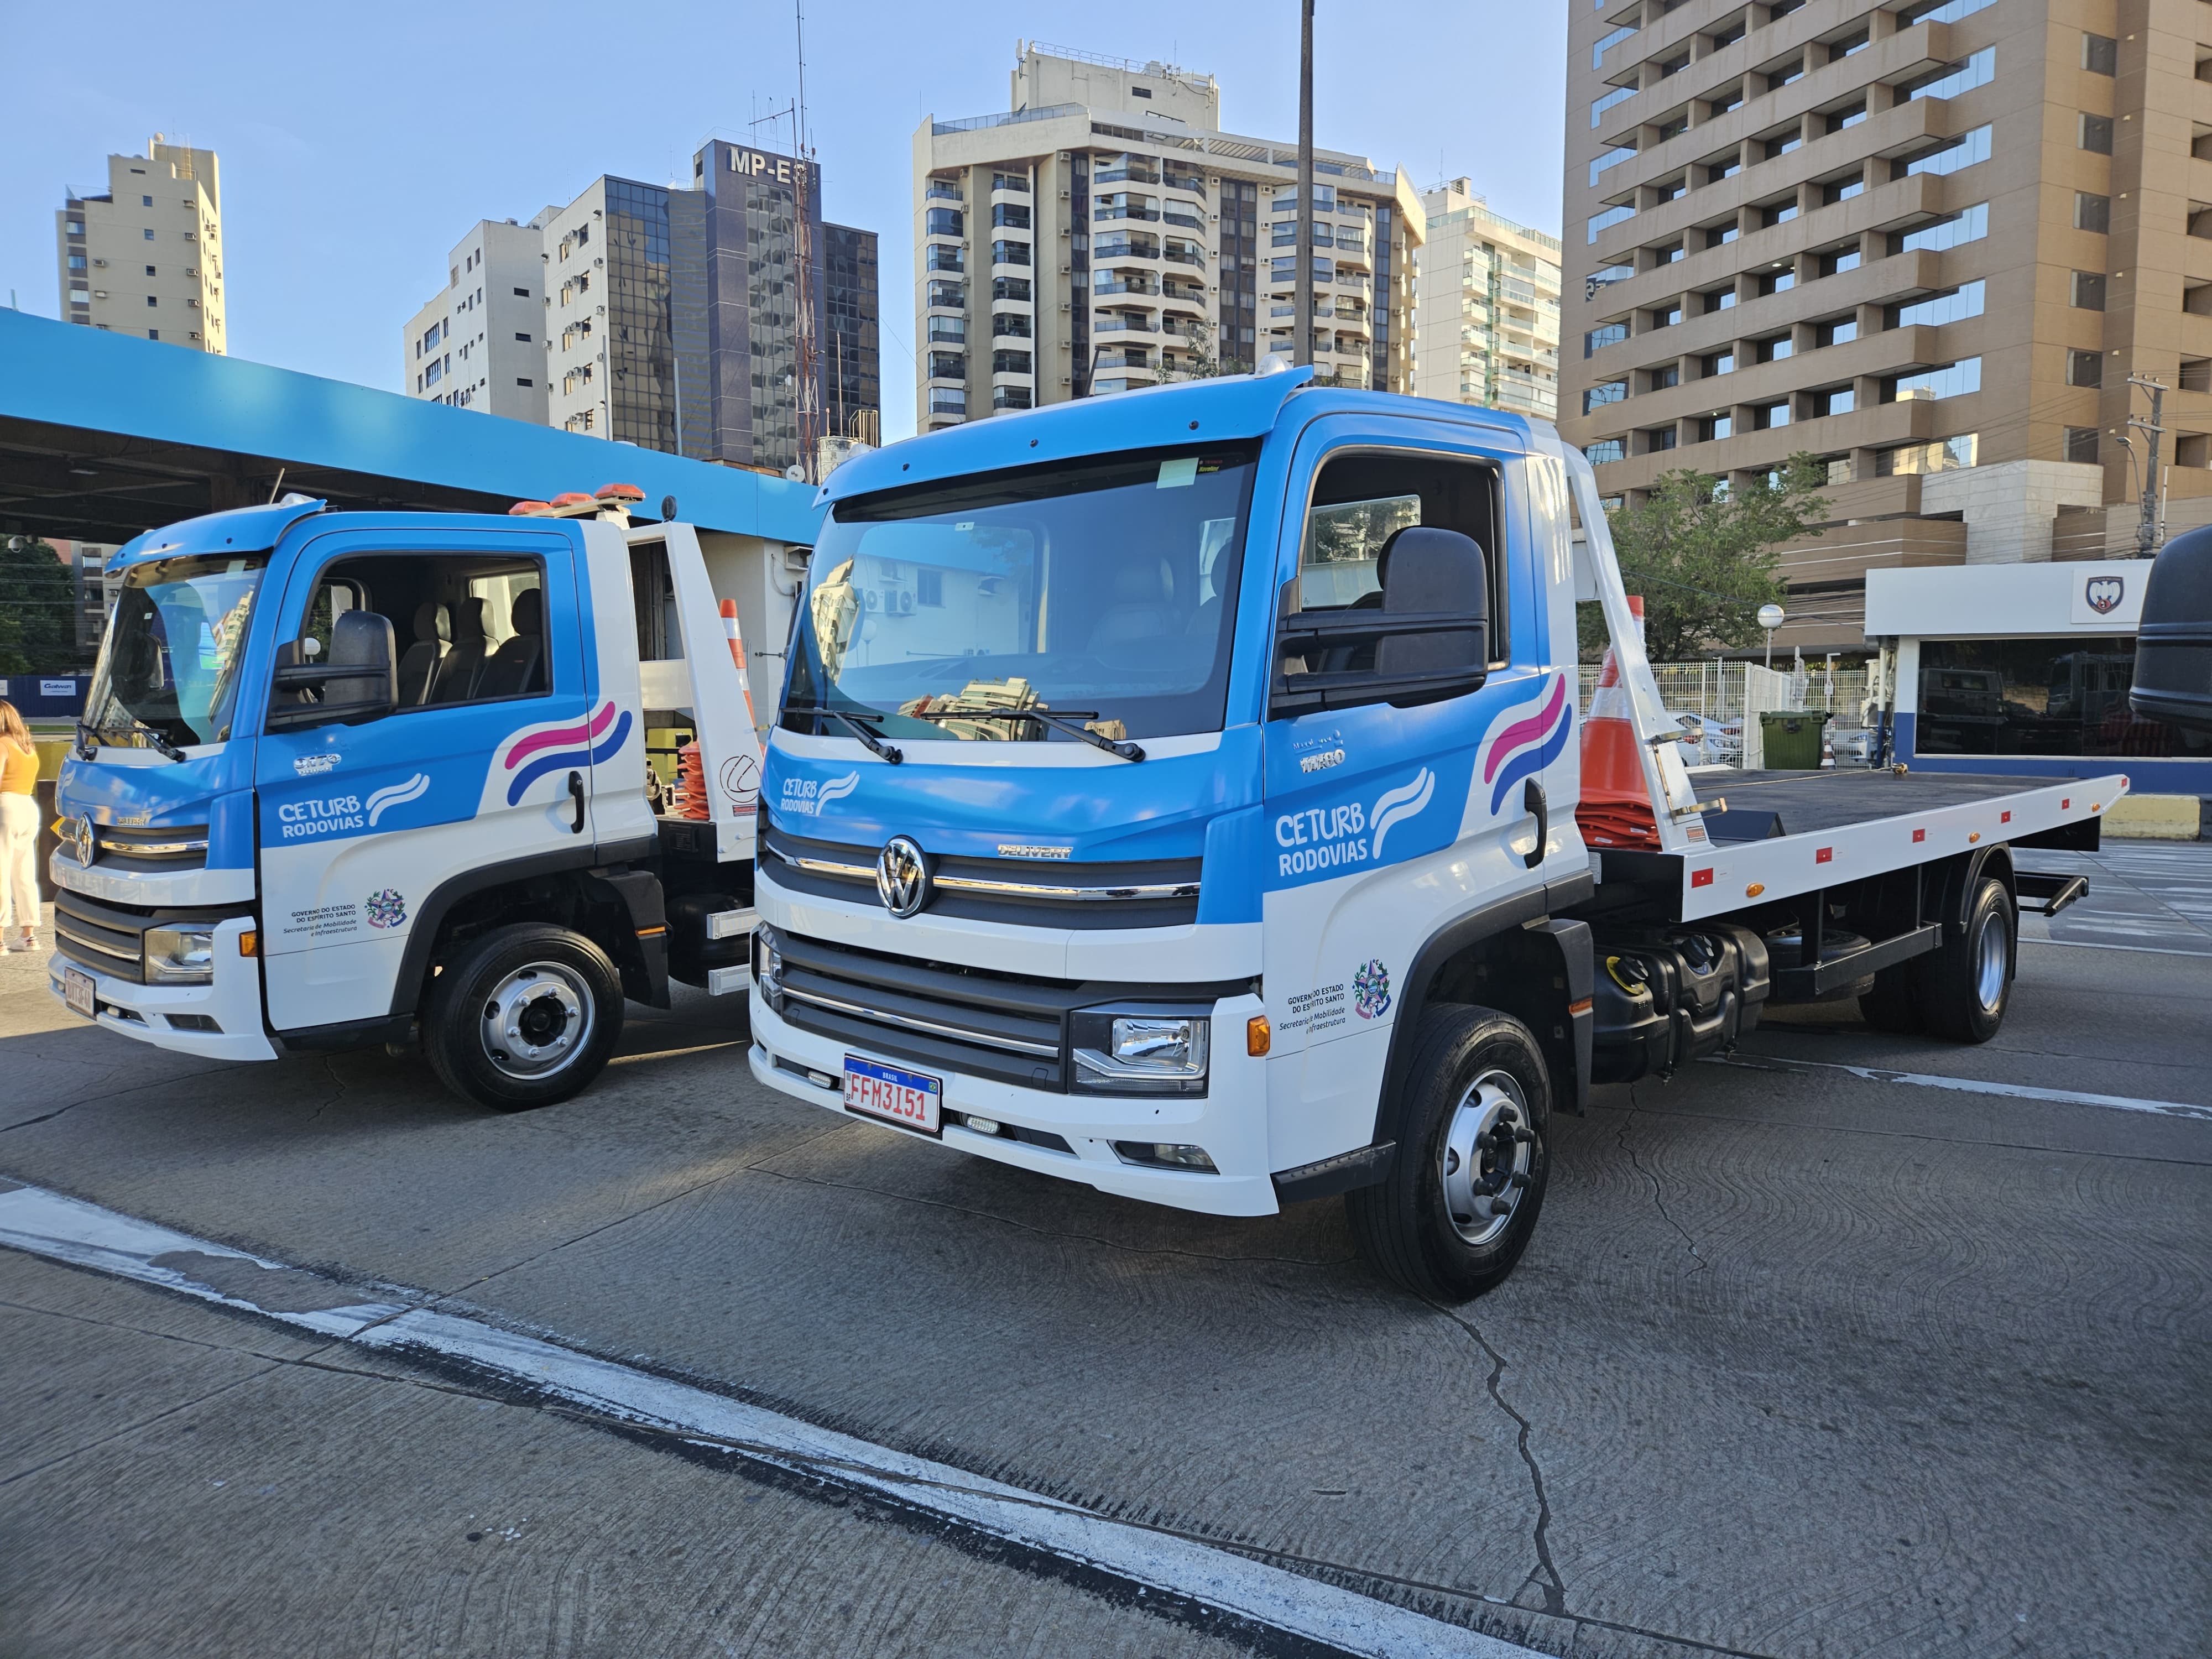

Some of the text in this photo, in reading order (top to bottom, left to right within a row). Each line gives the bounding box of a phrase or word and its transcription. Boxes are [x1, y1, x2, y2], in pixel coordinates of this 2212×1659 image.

[783, 778, 817, 799] CETURB
[279, 795, 361, 822] CETURB
[781, 798, 815, 814] RODOVIAS
[282, 815, 364, 838] RODOVIAS
[1276, 802, 1365, 847] CETURB
[998, 844, 1073, 859] DELIVERY
[1279, 838, 1368, 876] RODOVIAS
[283, 925, 314, 933] Secretaria
[323, 919, 357, 928] Mobilidade
[315, 926, 357, 937] Infraestrutura
[1288, 992, 1312, 1005] GOVERN
[1322, 984, 1344, 995] ESTADO
[1292, 993, 1344, 1014] DO ESRITO SANTO
[1314, 1006, 1345, 1020] Mobilidade
[1308, 1018, 1345, 1033] nfraestrutura
[883, 1072, 898, 1082] BRASIL
[851, 1073, 925, 1121] FFM3I51
